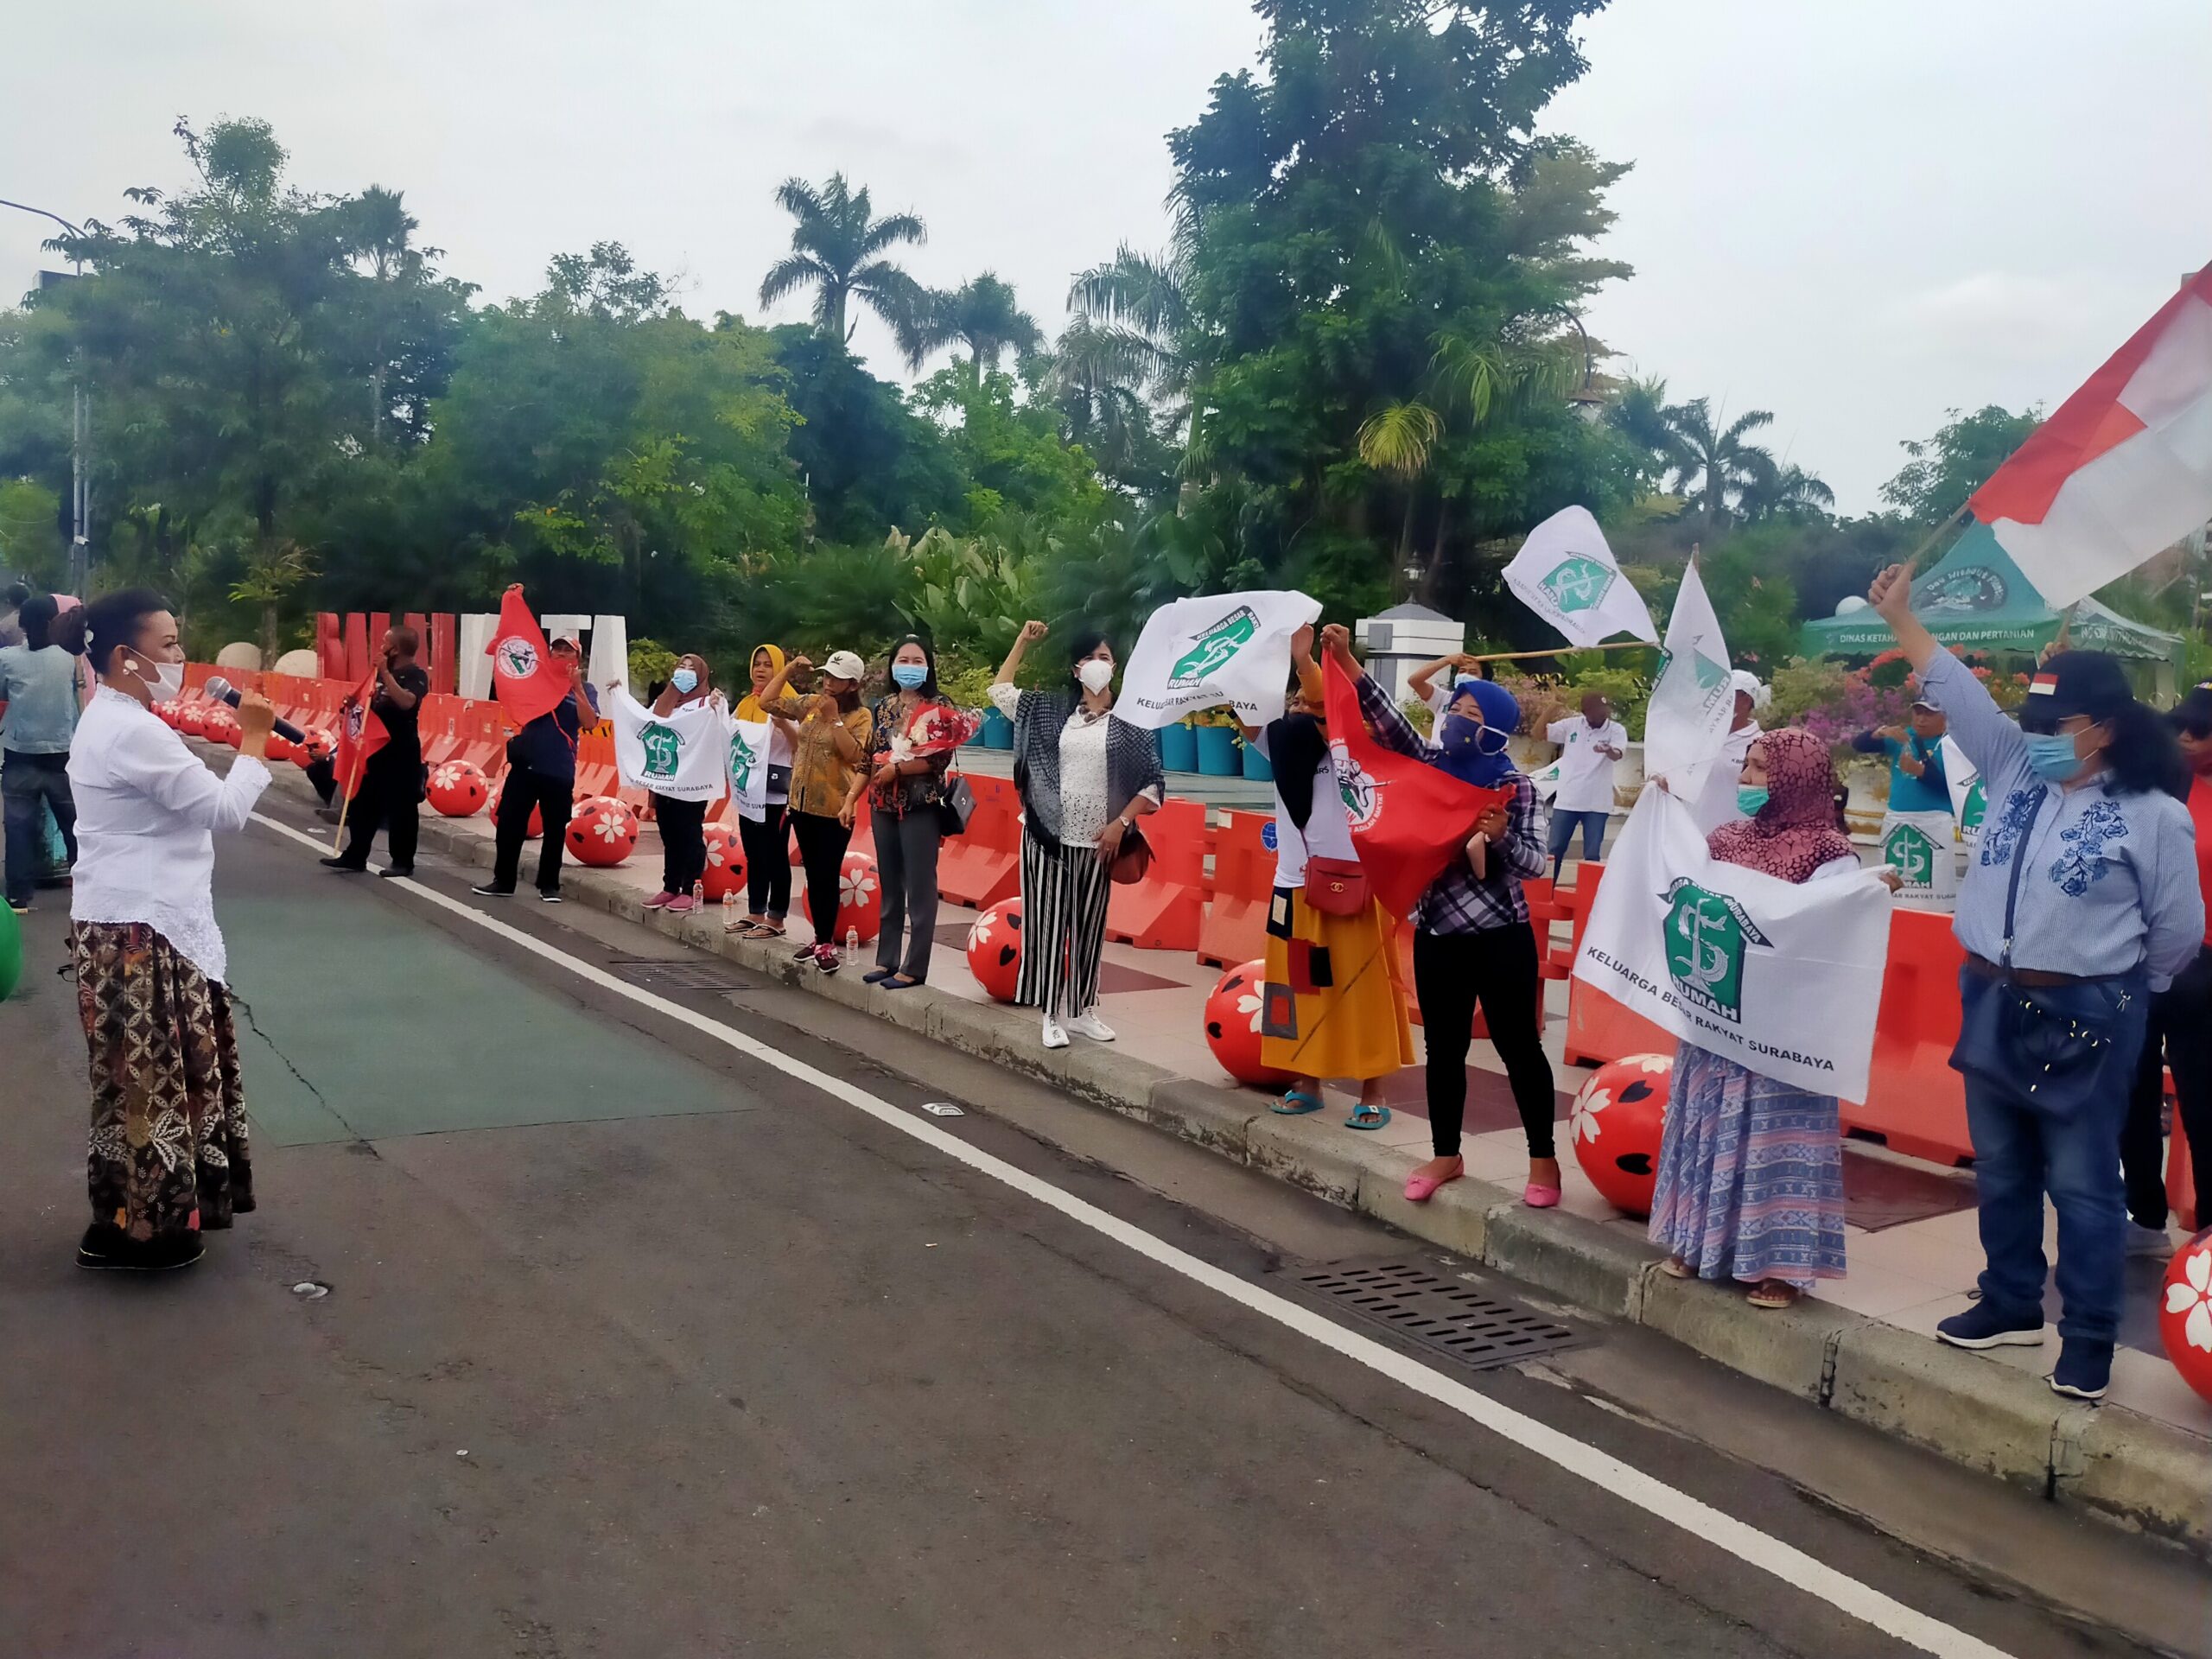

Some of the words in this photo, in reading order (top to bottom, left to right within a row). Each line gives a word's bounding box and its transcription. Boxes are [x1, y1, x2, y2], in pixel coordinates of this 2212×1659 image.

[1196, 620, 1230, 640] KELUARGA
[1227, 609, 1246, 626] BESAR
[1840, 633, 1866, 643] DINAS
[1959, 631, 1980, 640] DAN
[1980, 628, 2034, 639] PERTANIAN
[643, 770, 675, 781] RUMAH
[677, 784, 713, 792] SURABAYA
[1586, 945, 1658, 996] KELUARGA
[1695, 1015, 1745, 1046] RAKYAT
[1748, 1039, 1835, 1072] SURABAYA
[1671, 973, 1738, 1022] RUMAH
